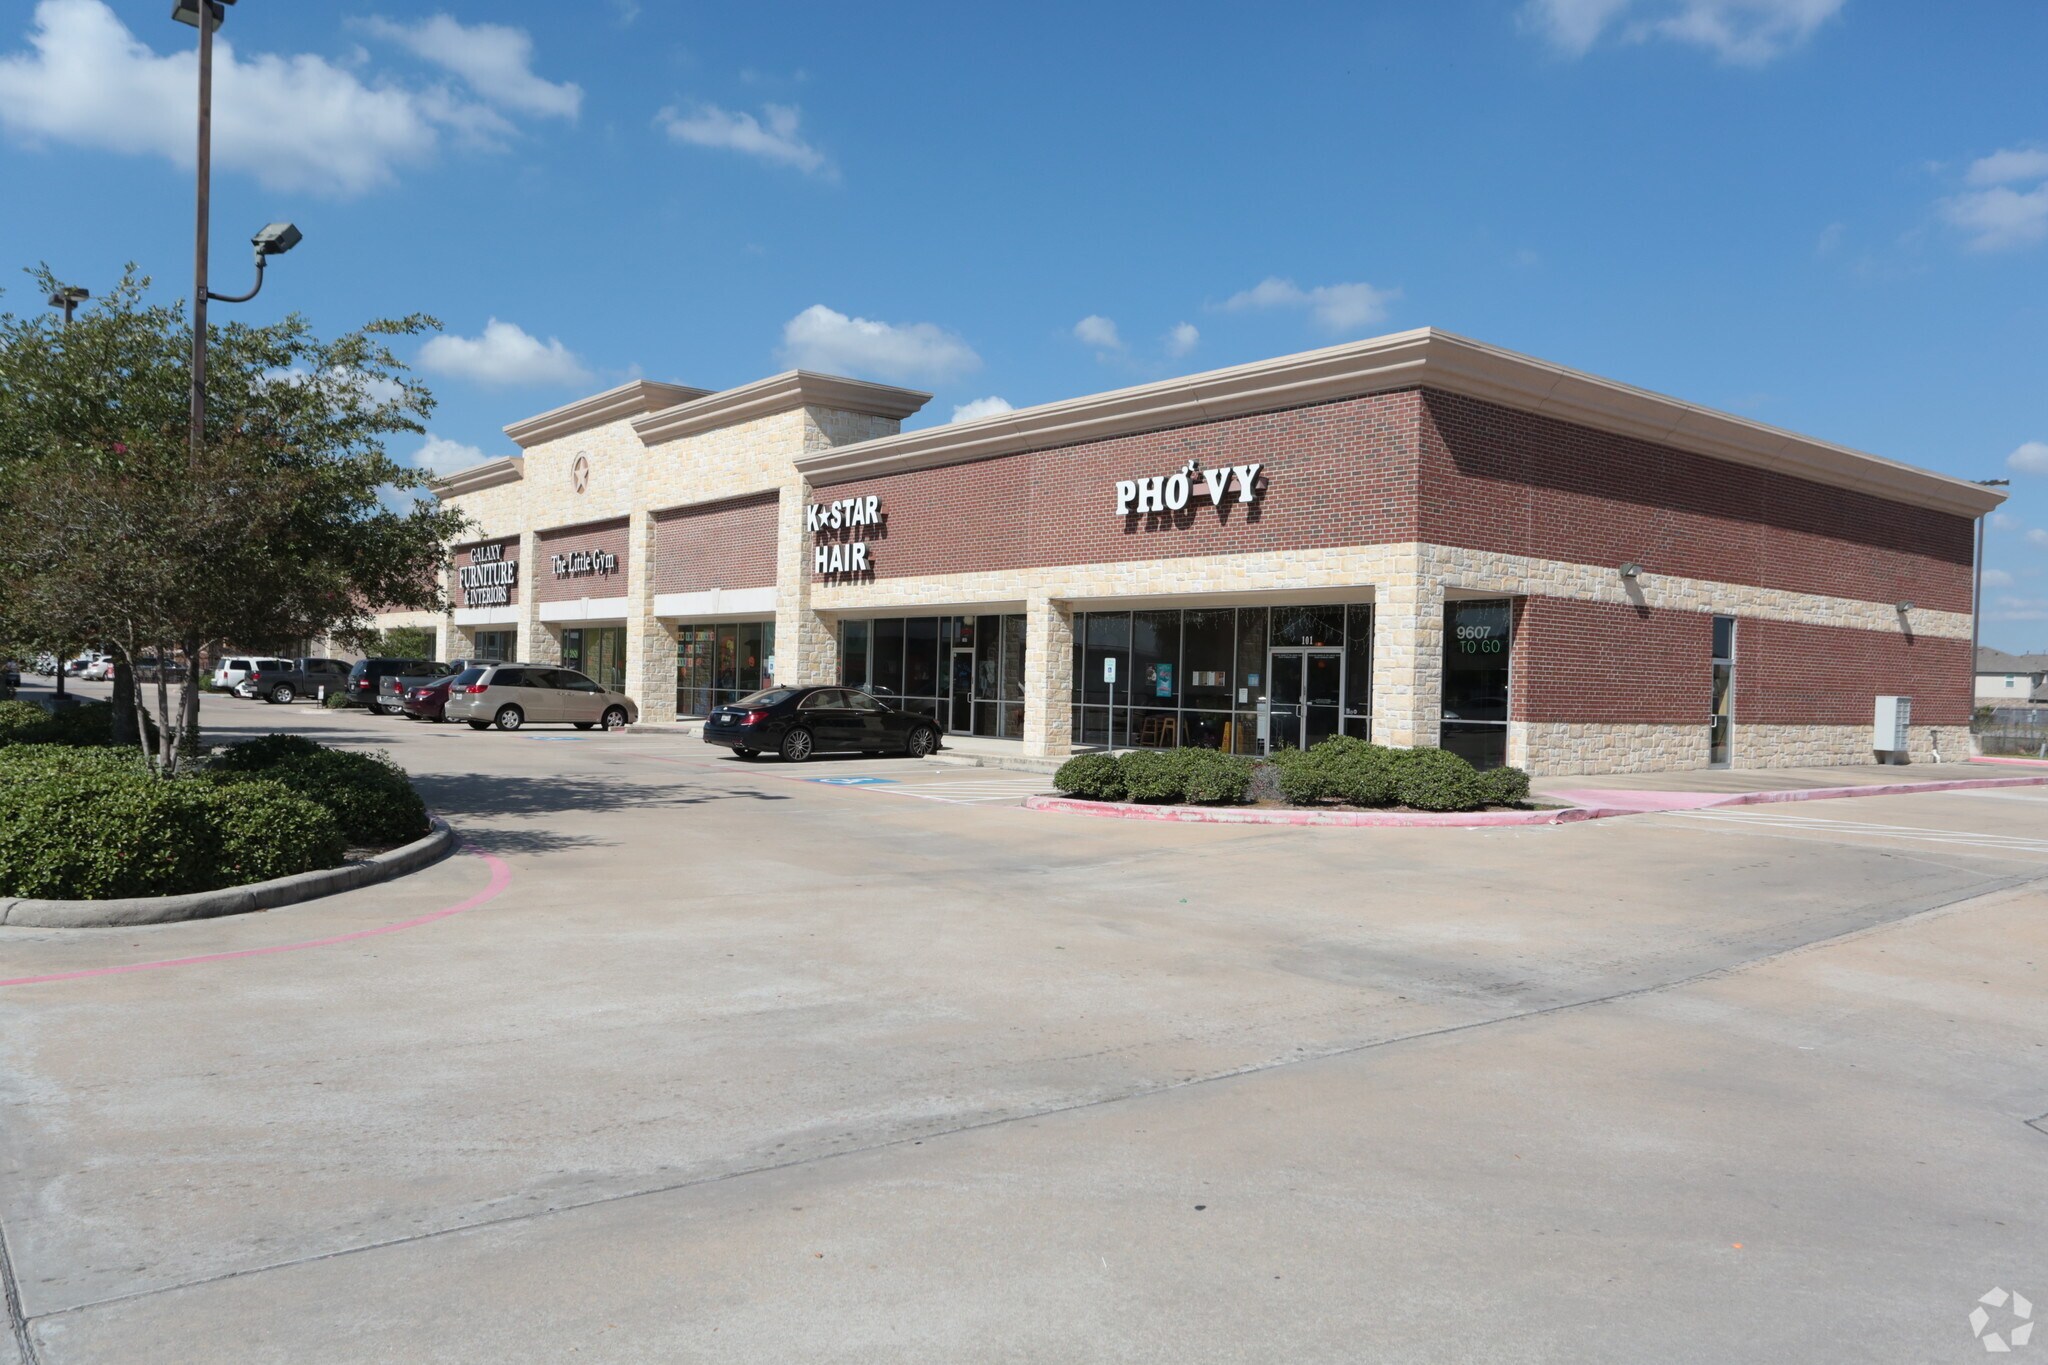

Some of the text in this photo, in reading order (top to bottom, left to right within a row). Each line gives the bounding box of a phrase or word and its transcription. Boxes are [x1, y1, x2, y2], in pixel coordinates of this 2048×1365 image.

[1203, 463, 1261, 506] VY
[470, 544, 502, 563] GALAXY
[551, 548, 614, 575] The Little Gym
[815, 542, 867, 574] HAIR
[459, 560, 515, 589] FURNITURE
[464, 586, 507, 605] & INTERIORS
[1301, 635, 1313, 646] 101
[1456, 626, 1492, 640] 9607
[1460, 639, 1501, 654] TO GO
